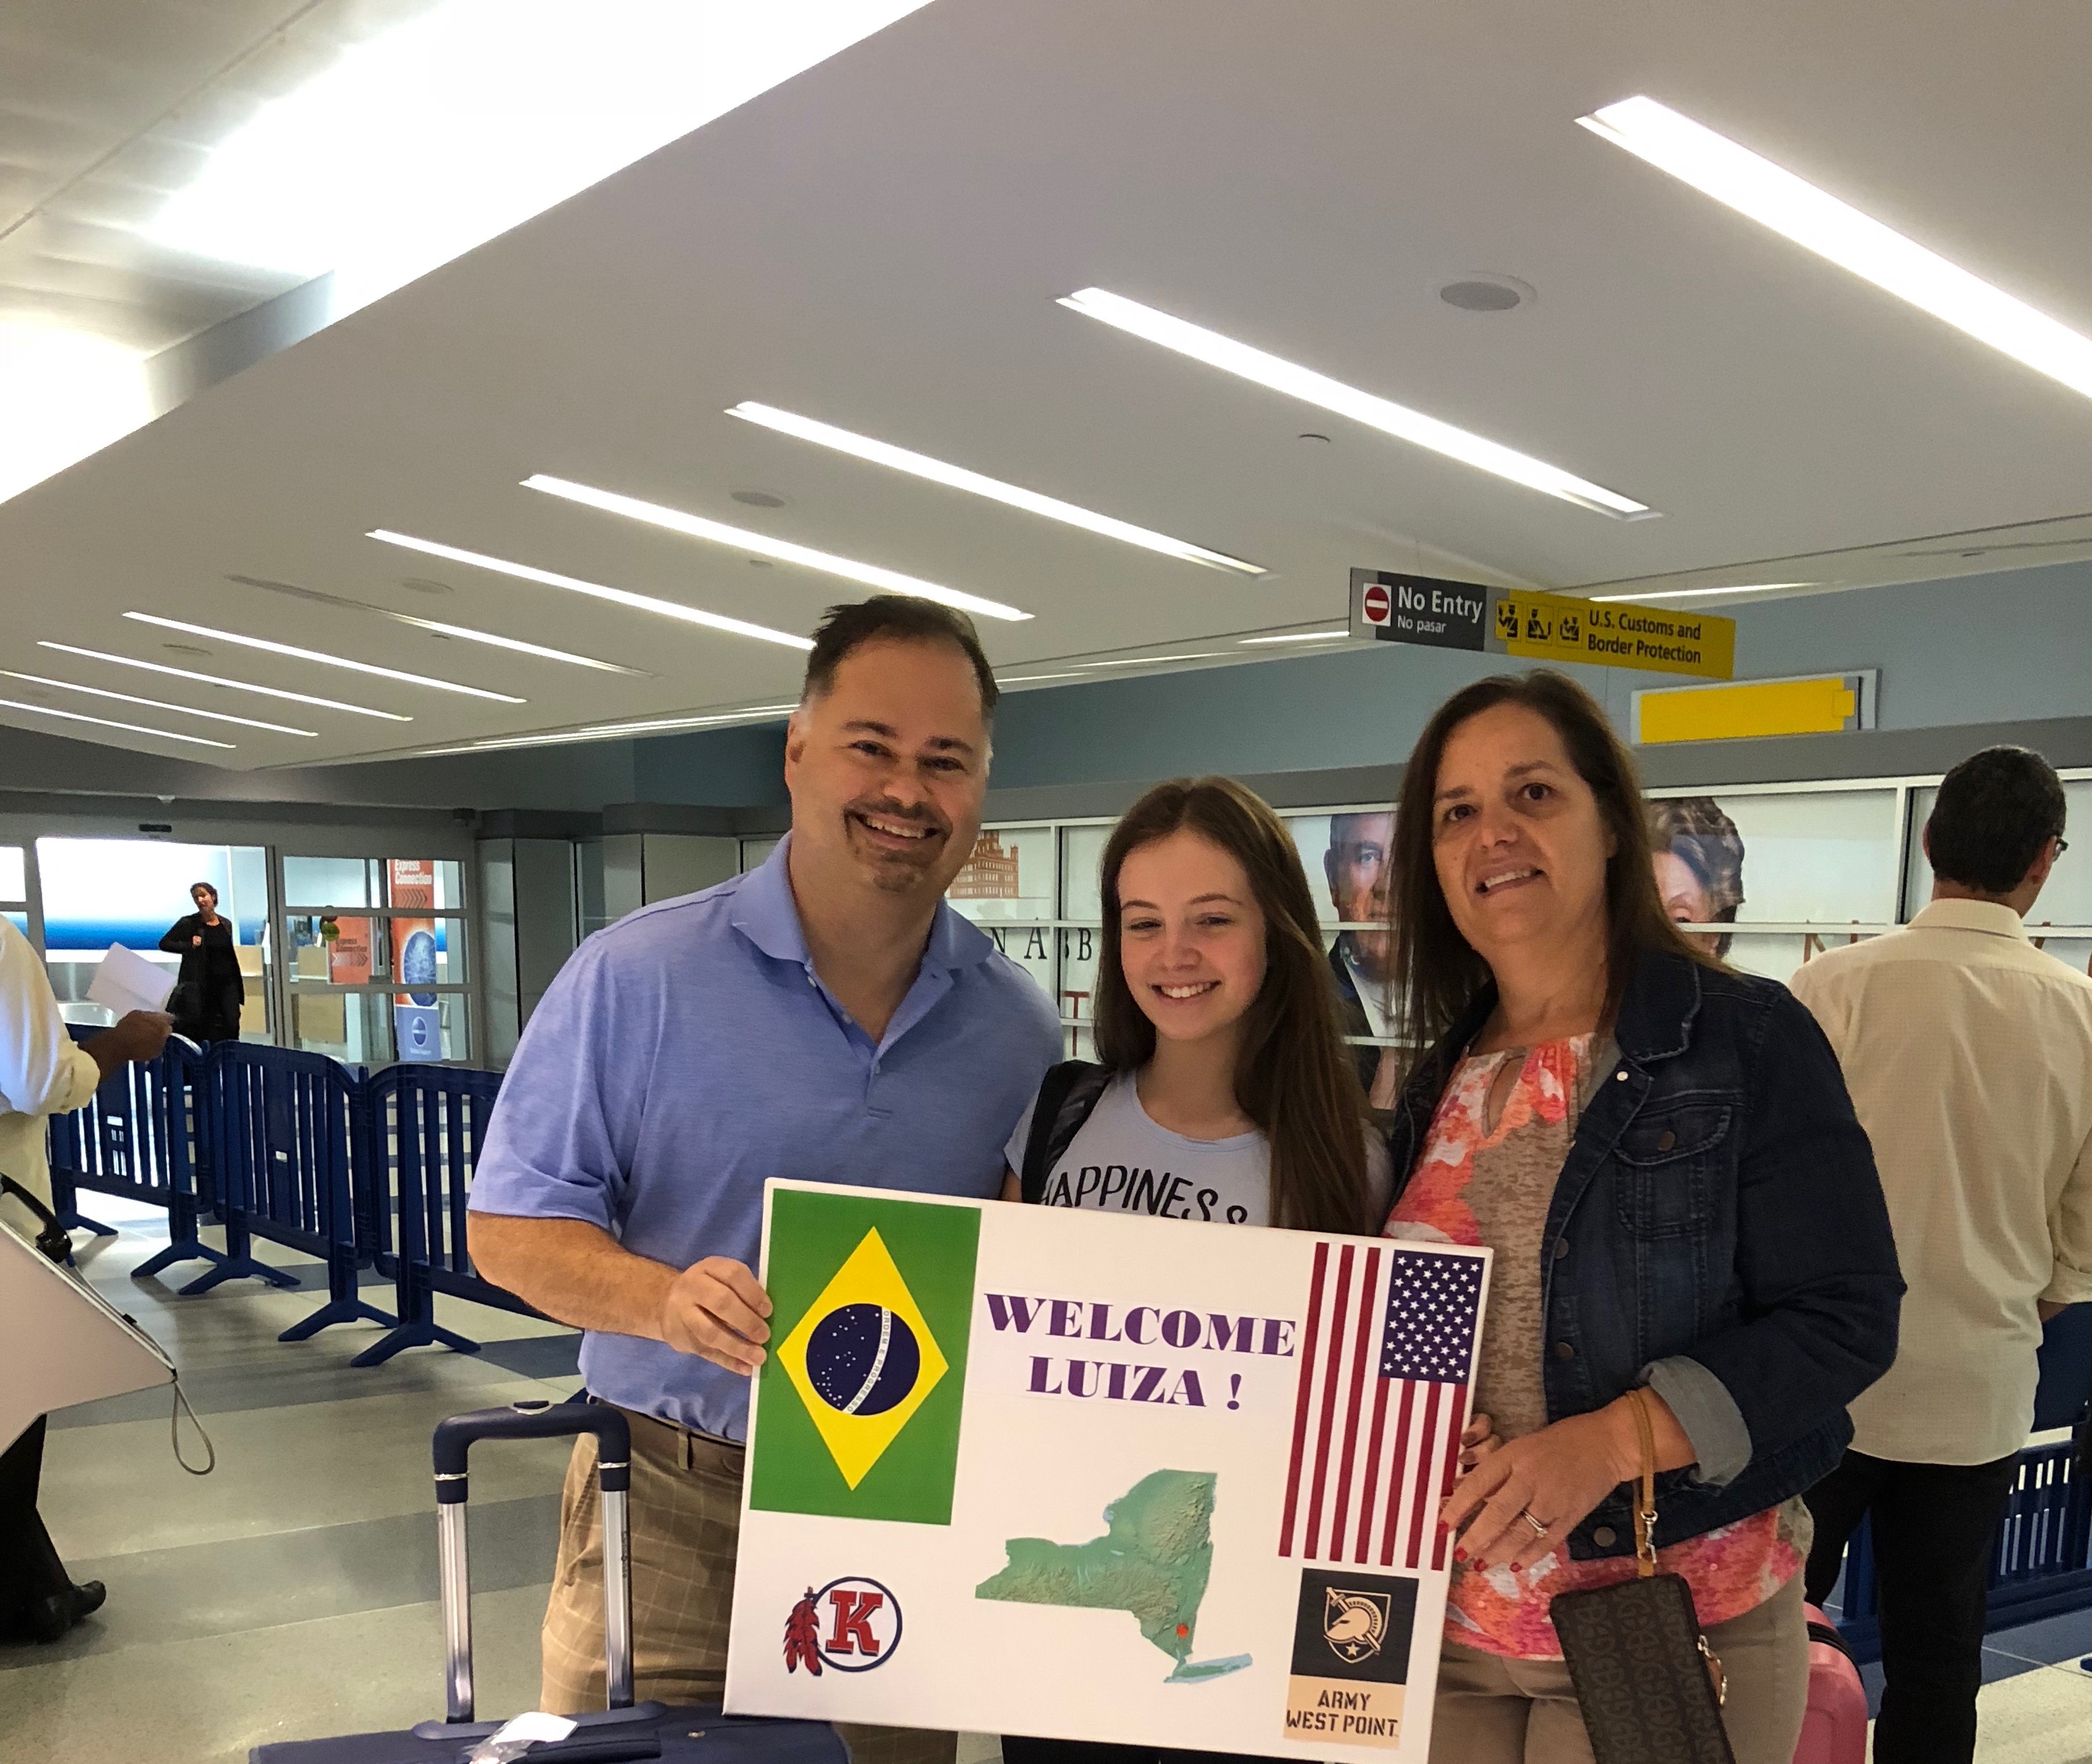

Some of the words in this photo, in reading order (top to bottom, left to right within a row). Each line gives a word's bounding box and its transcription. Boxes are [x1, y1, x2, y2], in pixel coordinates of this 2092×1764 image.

[1399, 586, 1425, 611] No
[1432, 590, 1482, 623] Entry
[1398, 614, 1413, 630] No
[1417, 619, 1447, 633] pasar
[1589, 609, 1615, 628] U.S.
[1619, 613, 1674, 636] Customs
[1677, 623, 1701, 640] and
[1588, 633, 1633, 655] Border
[1636, 640, 1701, 663] Protection
[984, 1293, 1296, 1357] WELCOME
[847, 1359, 883, 1412] PROGRESSO
[1026, 1356, 1207, 1407] LUIZA
[825, 1589, 884, 1657] K
[1317, 1690, 1371, 1711] ARMY
[1286, 1710, 1339, 1731] WEST
[1342, 1714, 1398, 1737] POINT
